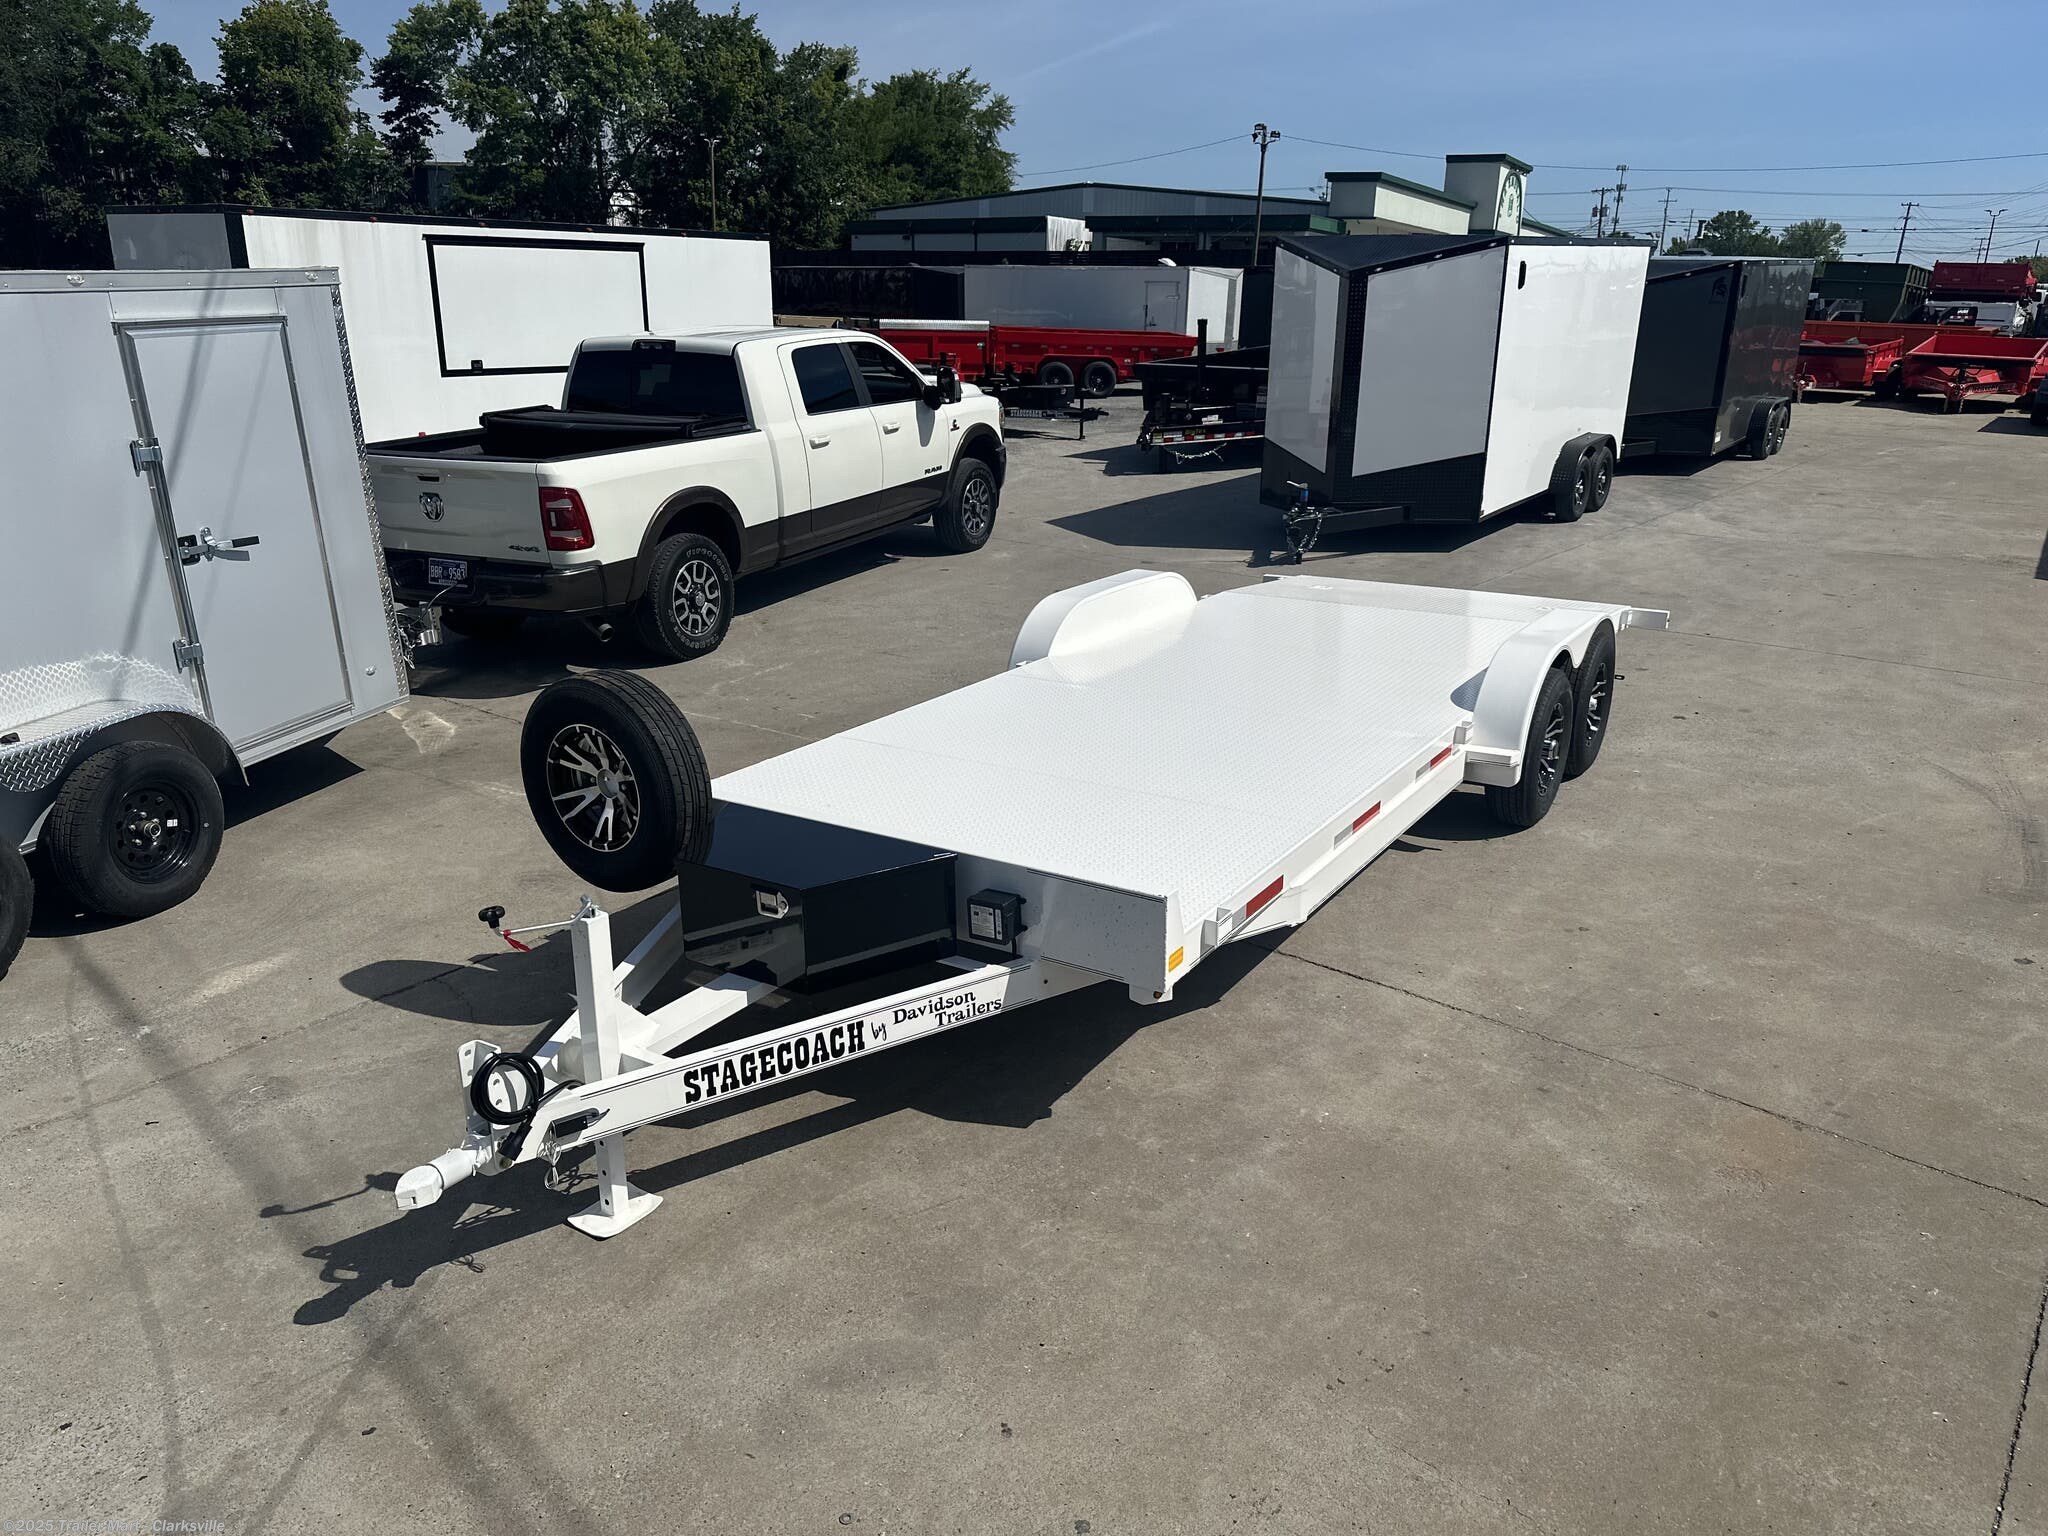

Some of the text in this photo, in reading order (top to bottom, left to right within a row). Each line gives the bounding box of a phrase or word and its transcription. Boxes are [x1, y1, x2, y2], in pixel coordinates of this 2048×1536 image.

[925, 465, 942, 475] RAM
[893, 991, 976, 1025] Davidson
[935, 998, 1002, 1027] Trailers
[683, 1020, 887, 1104] STAGECOACH by
